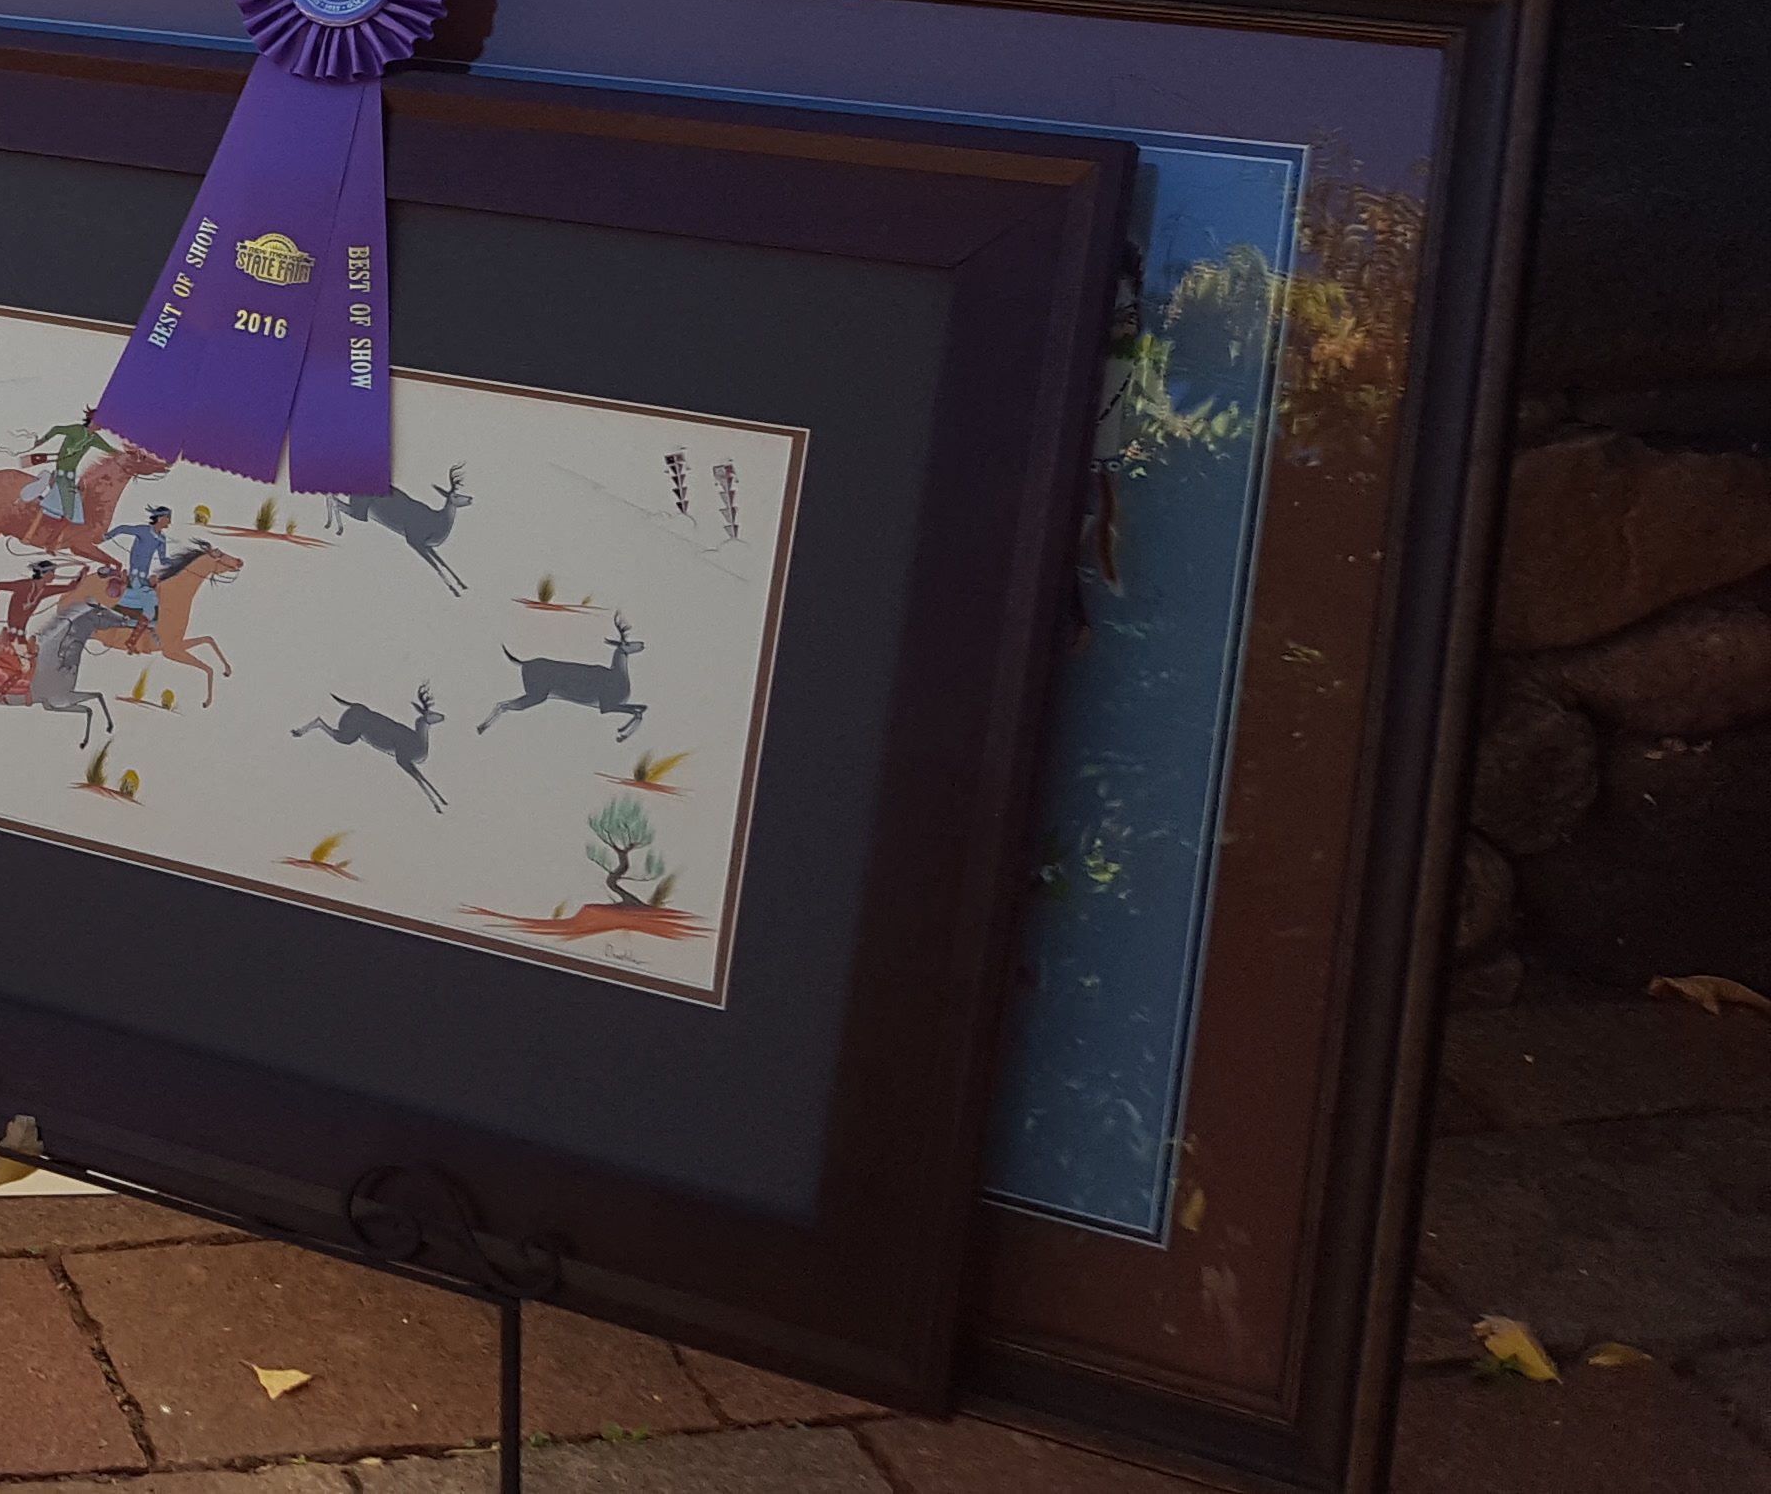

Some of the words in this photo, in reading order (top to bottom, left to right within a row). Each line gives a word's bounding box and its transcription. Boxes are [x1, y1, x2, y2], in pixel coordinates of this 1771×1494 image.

[147, 302, 182, 348] BEST
[172, 272, 194, 298] OF
[185, 216, 219, 268] SHOW
[237, 251, 276, 277] STATE
[276, 259, 311, 283] FAIR
[348, 246, 371, 293] BEST
[234, 309, 288, 339] 2016
[349, 303, 371, 326] OF
[349, 338, 372, 389] SHOW
